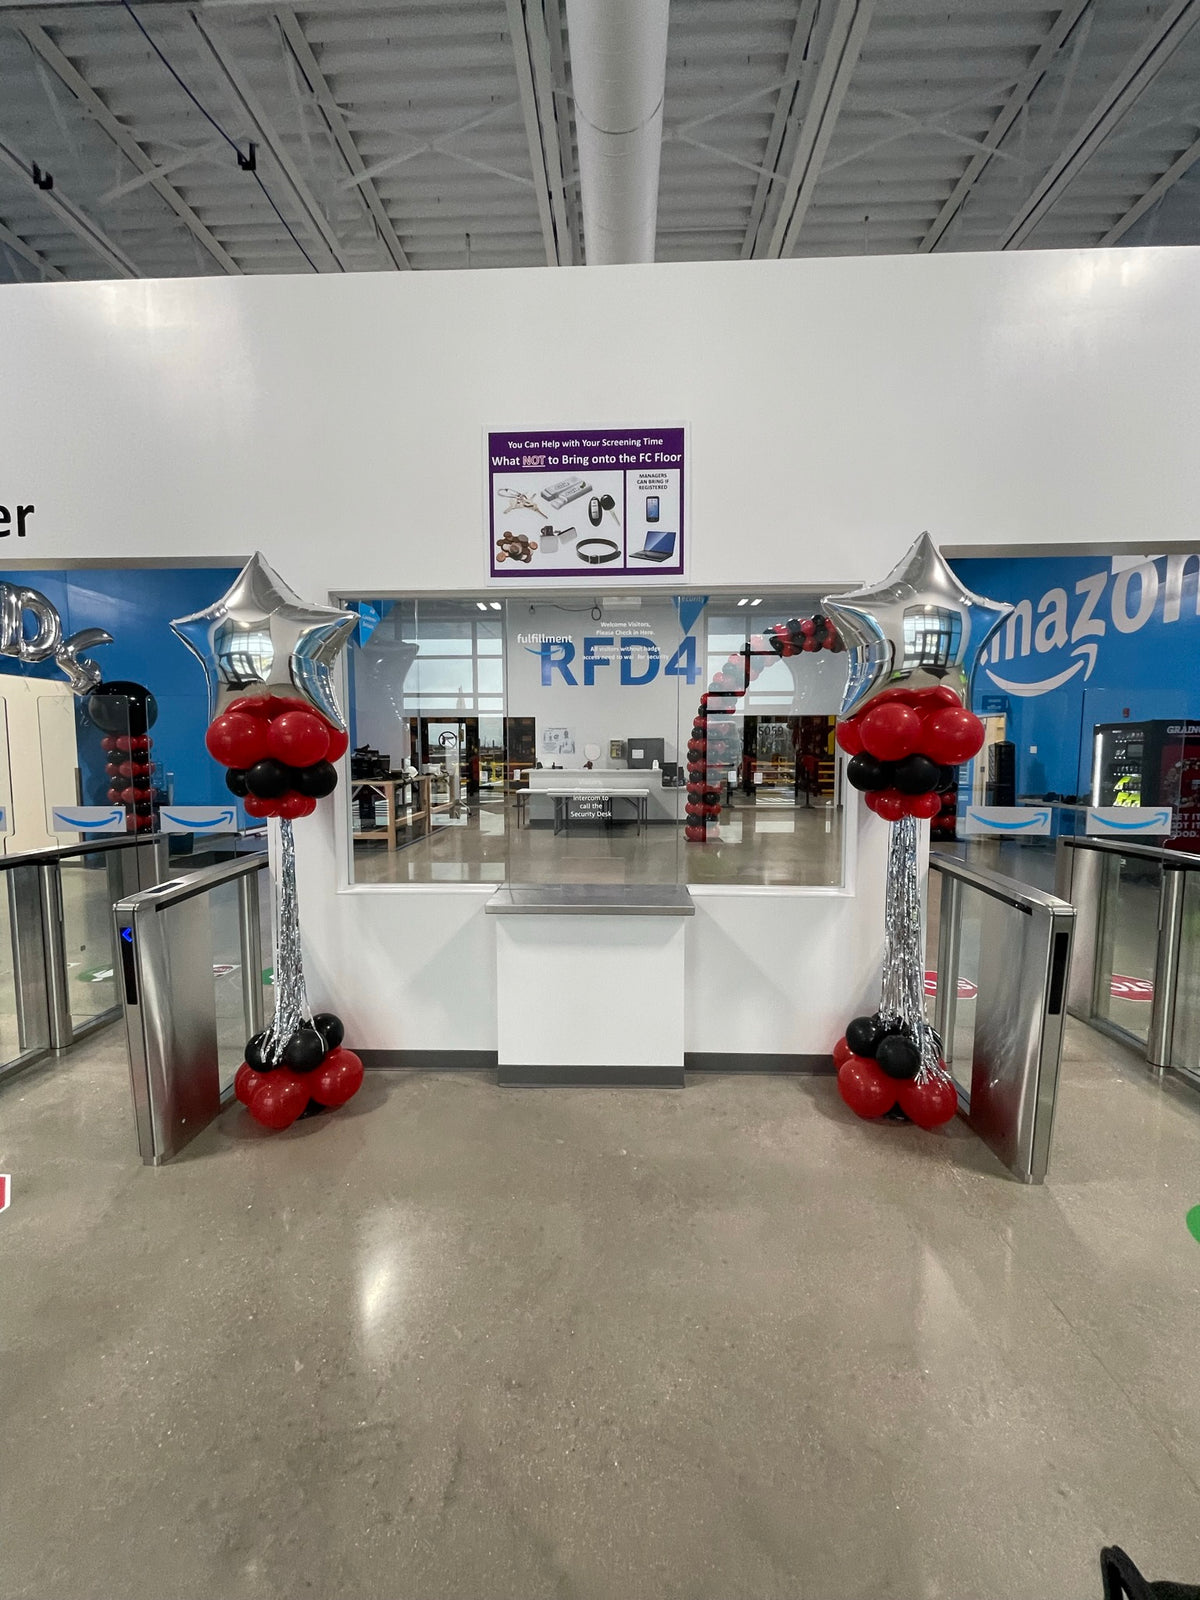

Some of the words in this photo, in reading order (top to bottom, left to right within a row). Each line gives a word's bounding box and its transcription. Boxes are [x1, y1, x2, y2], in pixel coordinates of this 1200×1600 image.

[508, 441, 523, 449] You
[524, 440, 540, 449] Can
[541, 440, 560, 450] Help
[562, 439, 580, 448] with
[582, 439, 600, 448] Your
[602, 438, 641, 447] Screening
[643, 437, 663, 446] Time
[491, 456, 520, 466] What
[522, 455, 546, 467] NOT
[548, 454, 559, 465] to
[562, 454, 589, 466] Bring
[592, 453, 616, 464] onto
[618, 453, 636, 463] the
[639, 452, 652, 463] FC
[654, 451, 682, 462] Floor
[981, 555, 1200, 666] mazon
[517, 633, 573, 644] fulfillment
[540, 636, 702, 686] RFD4
